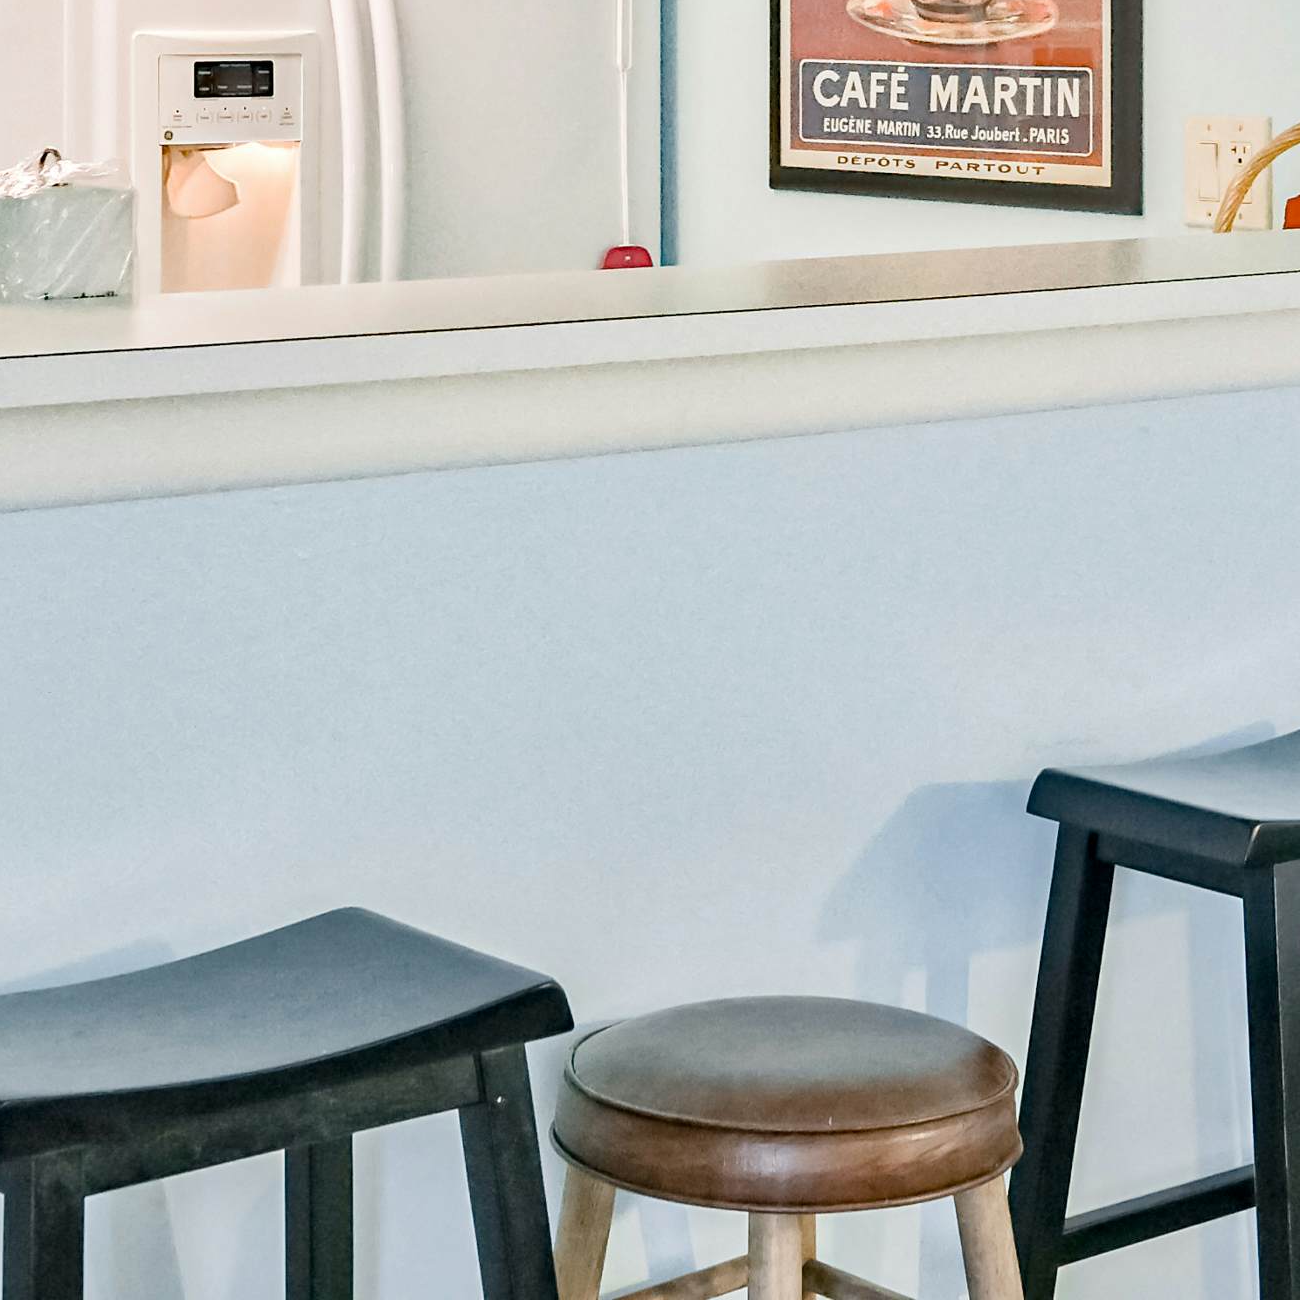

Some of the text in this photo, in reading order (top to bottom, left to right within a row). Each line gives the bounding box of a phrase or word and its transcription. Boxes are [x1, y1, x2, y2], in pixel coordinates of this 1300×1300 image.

[813, 67, 1080, 118] CAFÉ MARTIN
[876, 120, 920, 137] MARTIN
[971, 125, 1020, 142] Joubert
[935, 160, 1045, 175] PARTOUT
